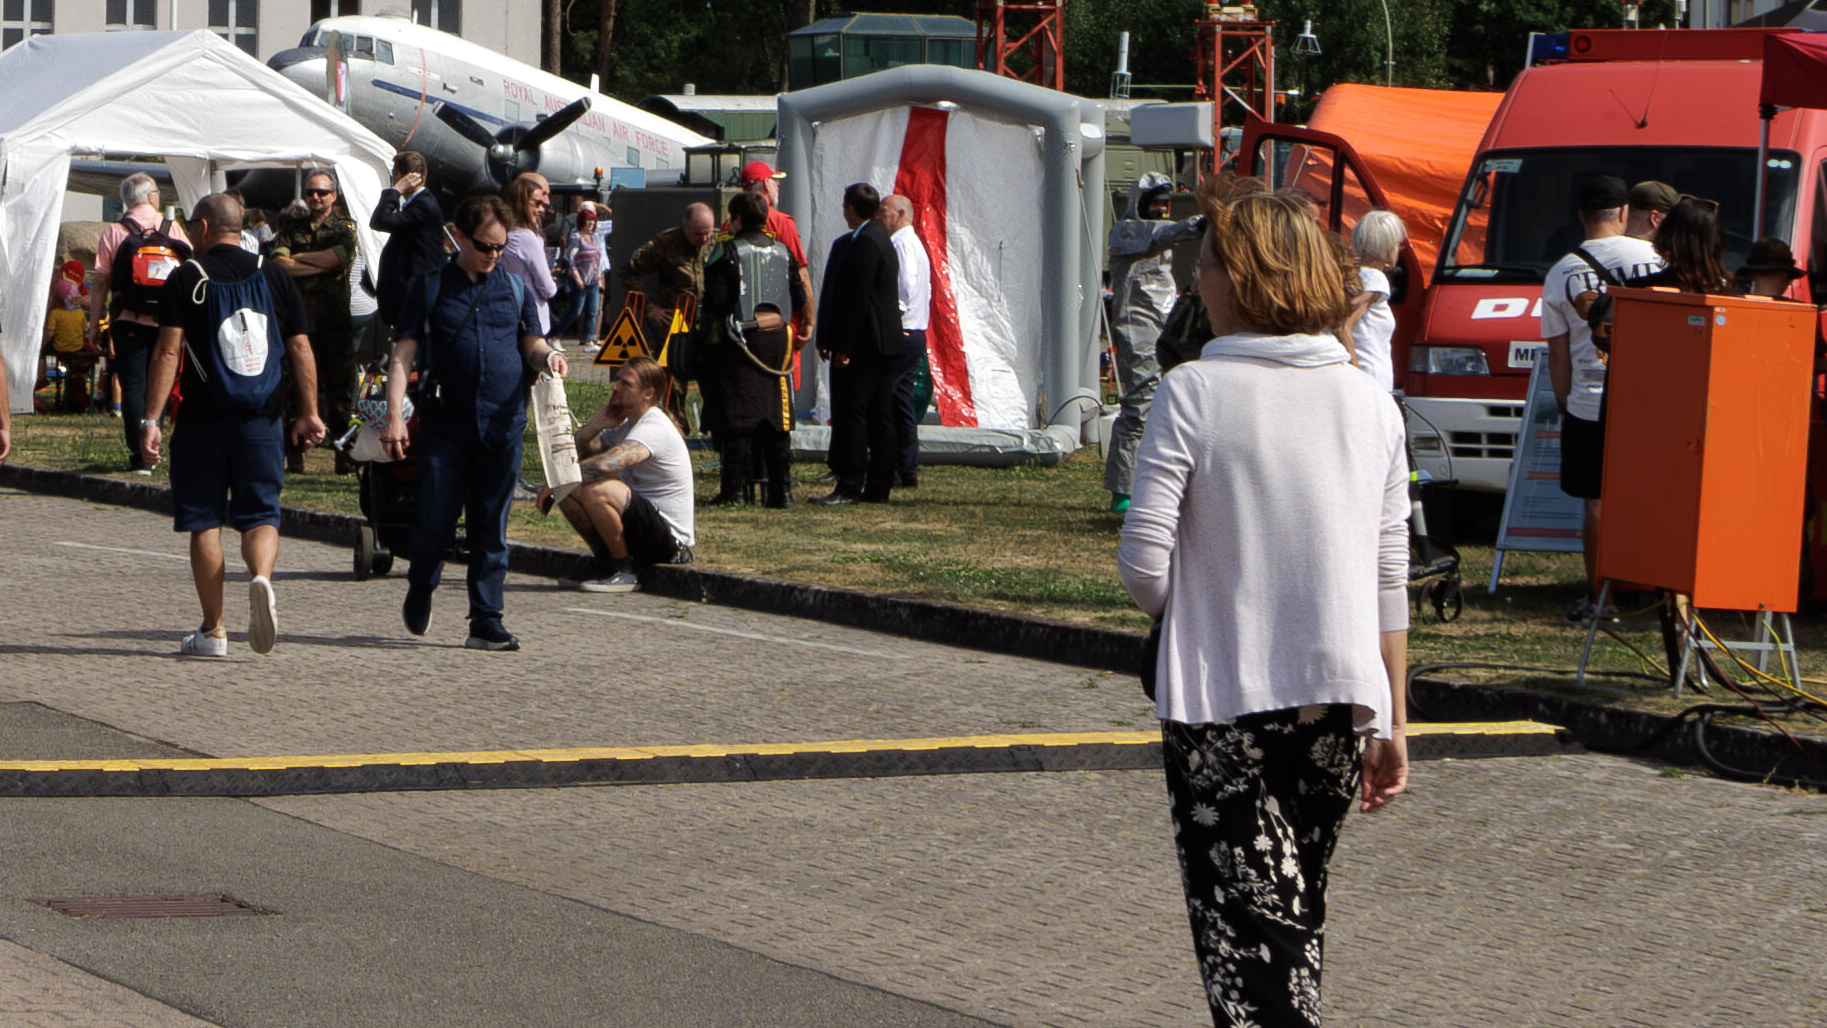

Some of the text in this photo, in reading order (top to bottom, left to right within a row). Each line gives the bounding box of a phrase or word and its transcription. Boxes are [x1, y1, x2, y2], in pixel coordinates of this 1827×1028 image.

[503, 79, 538, 106] ROYAL
[613, 121, 629, 141] AIR
[635, 131, 669, 157] FORCE
